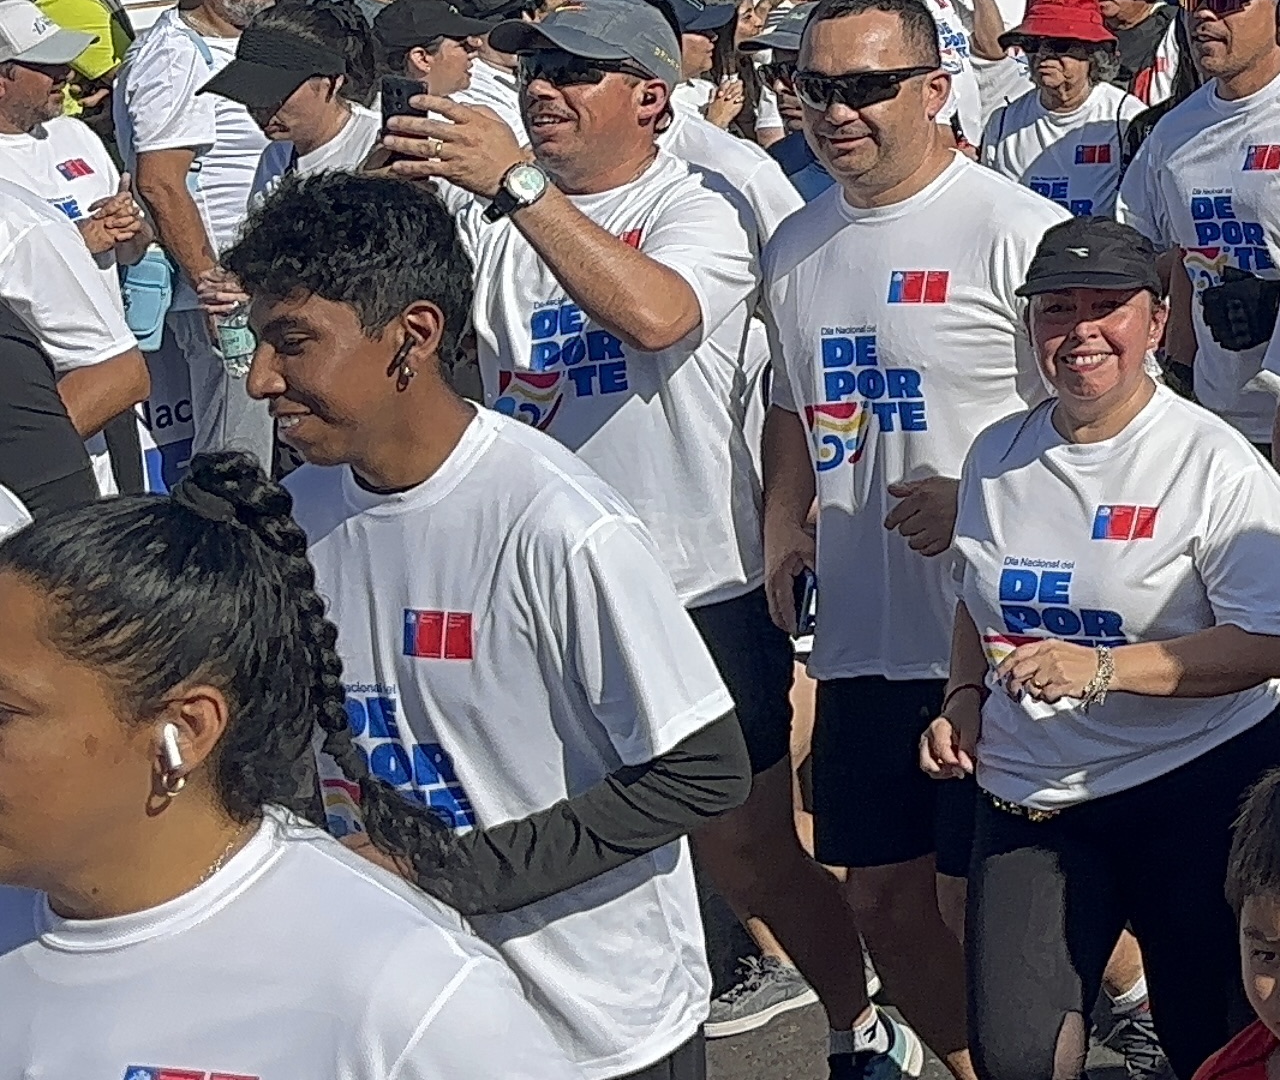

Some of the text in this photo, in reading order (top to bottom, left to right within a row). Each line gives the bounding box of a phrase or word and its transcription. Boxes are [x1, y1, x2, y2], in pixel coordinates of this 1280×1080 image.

[1191, 196, 1236, 219] DE
[1195, 222, 1267, 246] POR
[1234, 246, 1275, 270] TE
[531, 305, 583, 340] DE
[529, 330, 625, 372] POR
[821, 335, 878, 368] DE
[568, 360, 628, 397] TE
[824, 368, 923, 402] POR
[872, 401, 927, 432] TE
[999, 569, 1072, 604] DE
[1000, 605, 1127, 637] POR
